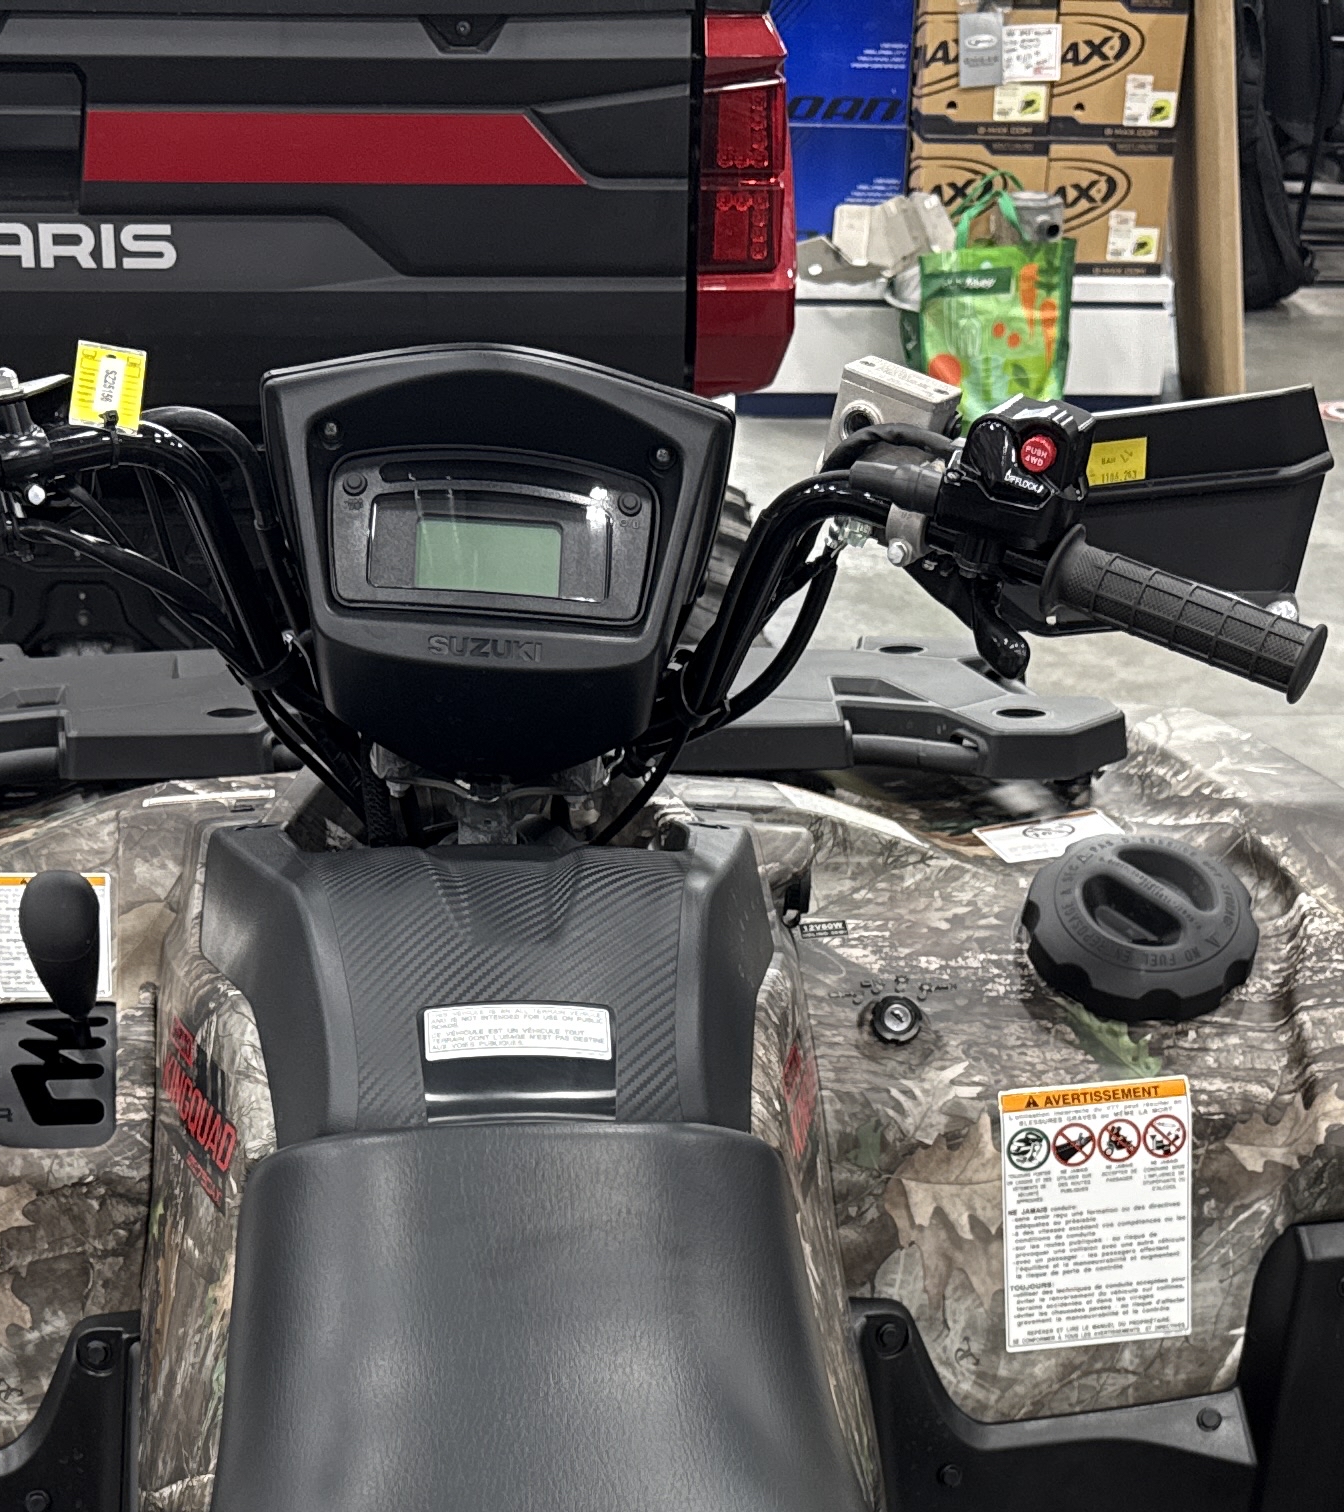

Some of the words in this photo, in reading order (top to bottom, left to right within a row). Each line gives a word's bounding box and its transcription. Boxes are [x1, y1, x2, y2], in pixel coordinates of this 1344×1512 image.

[1025, 445, 1048, 458] PUSH
[1024, 455, 1044, 467] 4WD
[427, 634, 544, 663] SUZUKI
[1143, 952, 1176, 967] FUEL
[1044, 1086, 1160, 1107] AVERTISSEMENT
[162, 1051, 237, 1172] KINGQUAD
